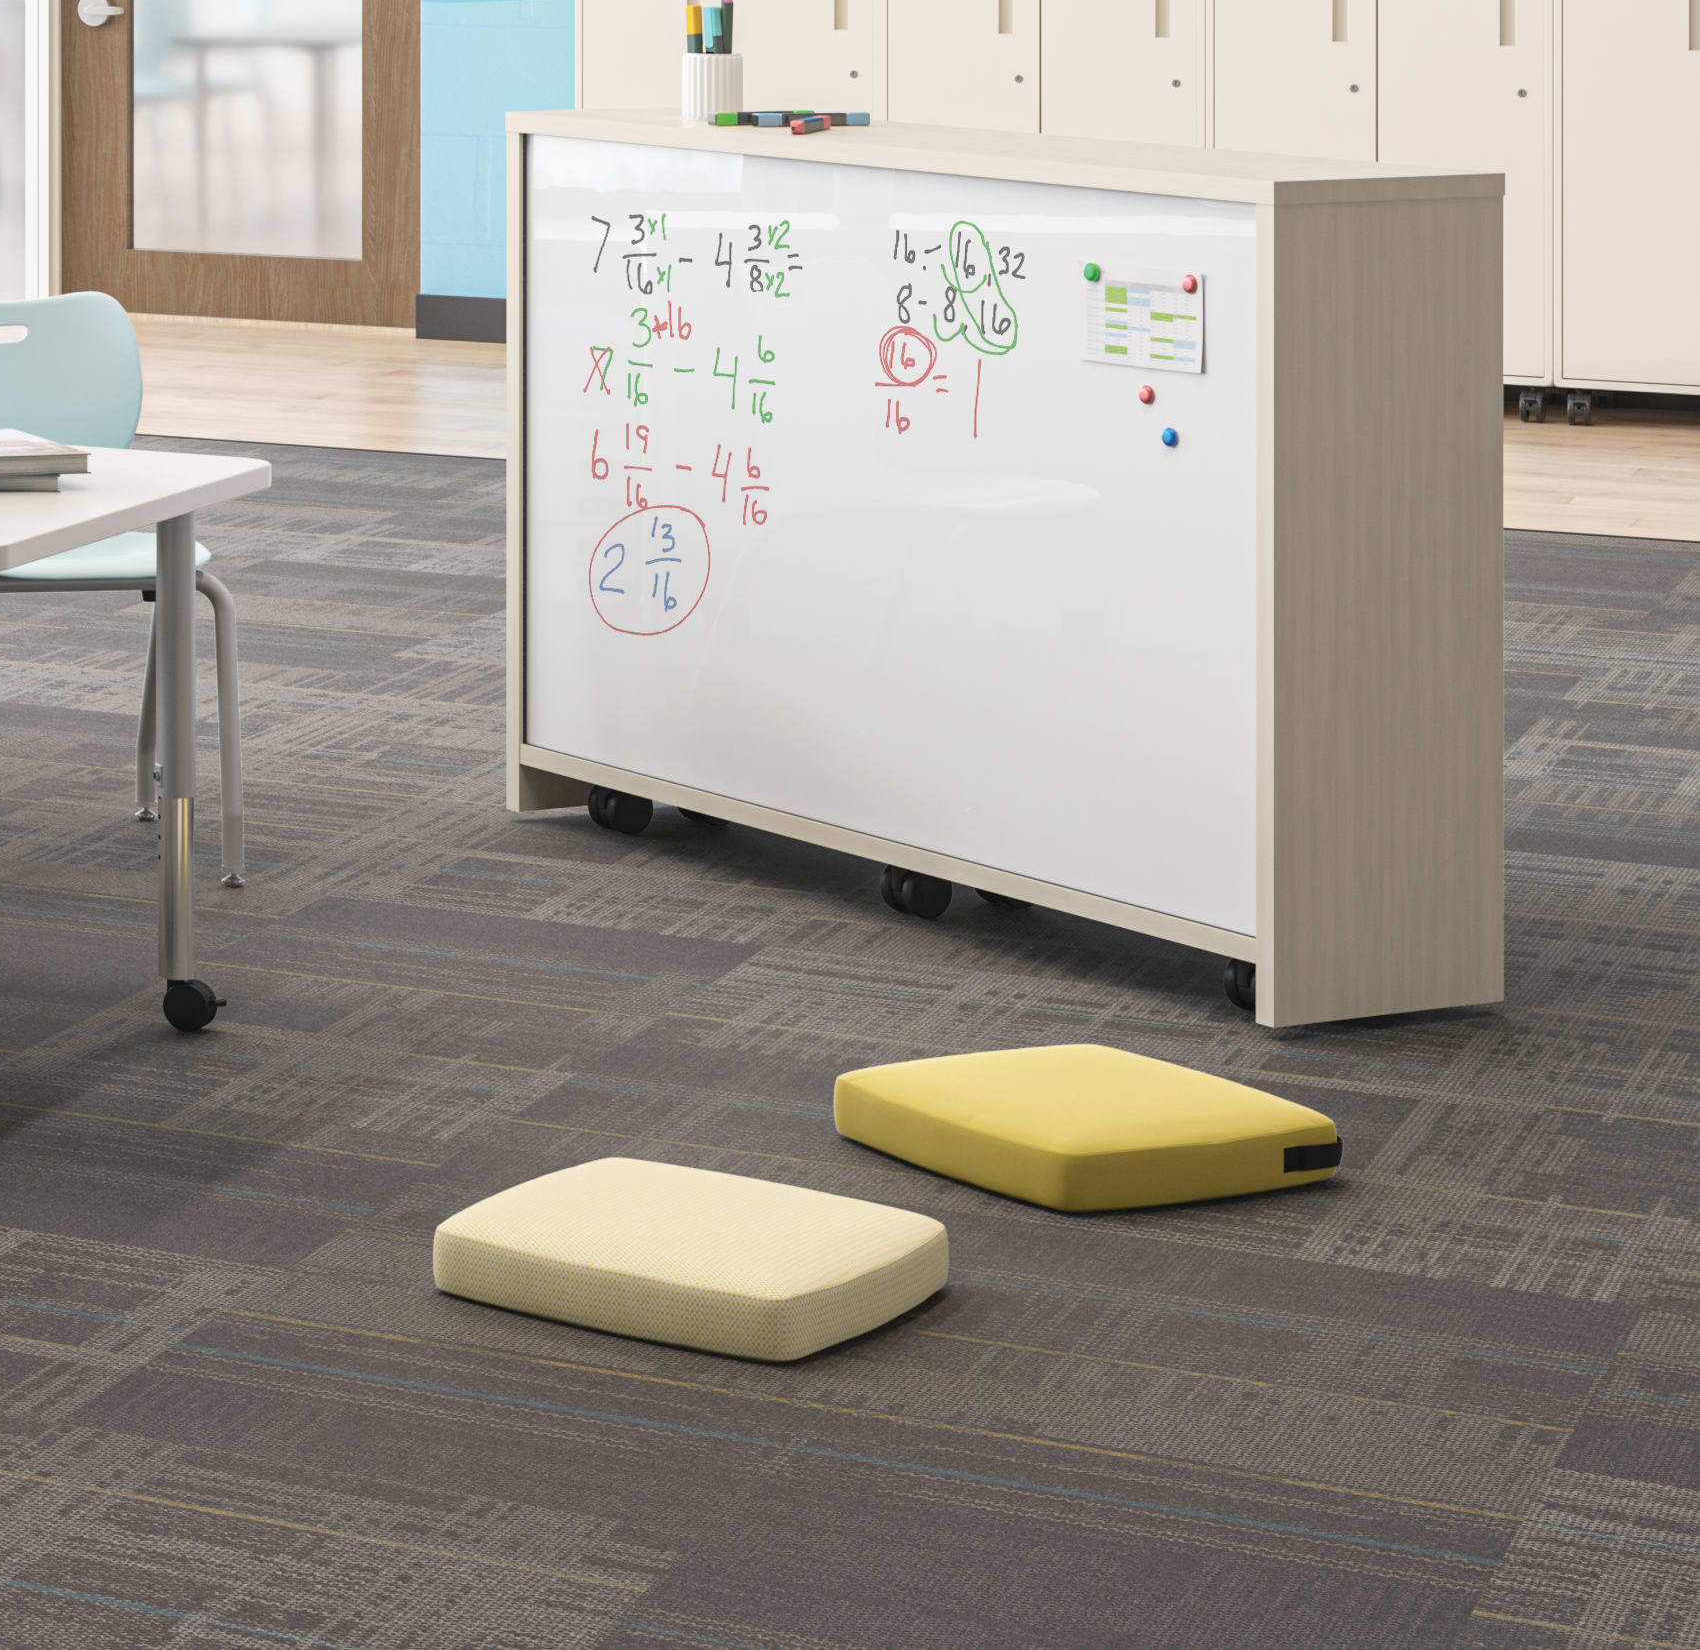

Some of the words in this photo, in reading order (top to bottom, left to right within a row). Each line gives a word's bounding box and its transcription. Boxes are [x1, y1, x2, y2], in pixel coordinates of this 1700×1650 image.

[591, 215, 611, 273] 7
[715, 232, 733, 288] 4
[998, 246, 1027, 280] 32
[896, 283, 913, 324] 8
[981, 300, 1012, 335] 16
[757, 334, 776, 364] 6
[888, 340, 916, 370] 16
[627, 372, 650, 407] 16
[751, 391, 774, 424] 16
[713, 347, 738, 410] 4
[885, 398, 911, 435] 16
[591, 429, 610, 481] 6
[711, 443, 733, 503] 4
[625, 422, 650, 454] 19
[747, 447, 761, 479] 6
[626, 475, 649, 509] 16
[742, 493, 769, 526] 16
[650, 516, 676, 553] 13
[599, 543, 626, 595] 2
[651, 571, 678, 612] 16
